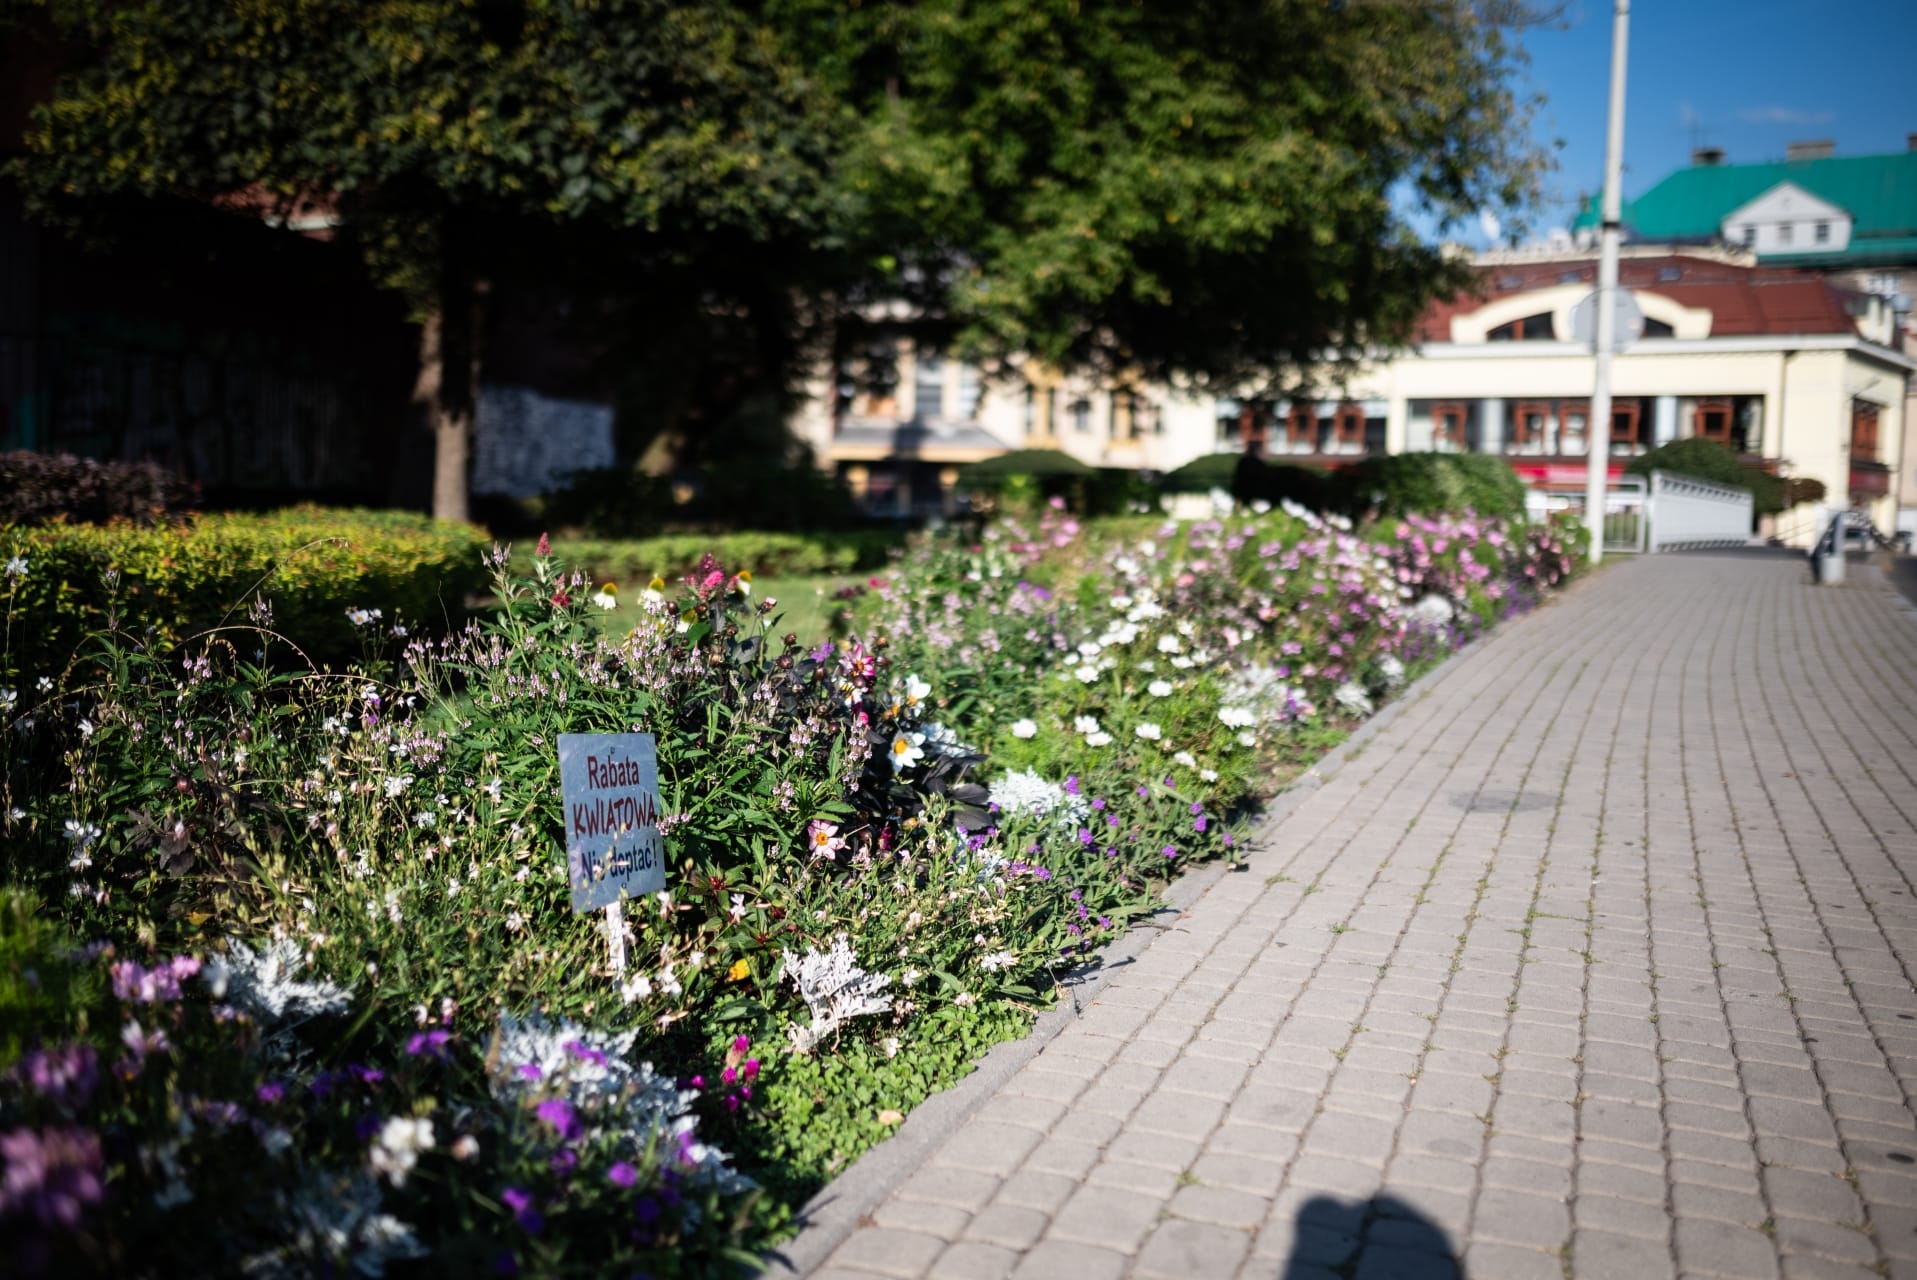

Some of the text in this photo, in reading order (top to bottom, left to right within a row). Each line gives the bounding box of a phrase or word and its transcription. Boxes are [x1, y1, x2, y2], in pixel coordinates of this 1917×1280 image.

[587, 754, 640, 790] Rabata
[573, 791, 658, 840] KWIATOWA
[610, 838, 657, 882] deptać!
